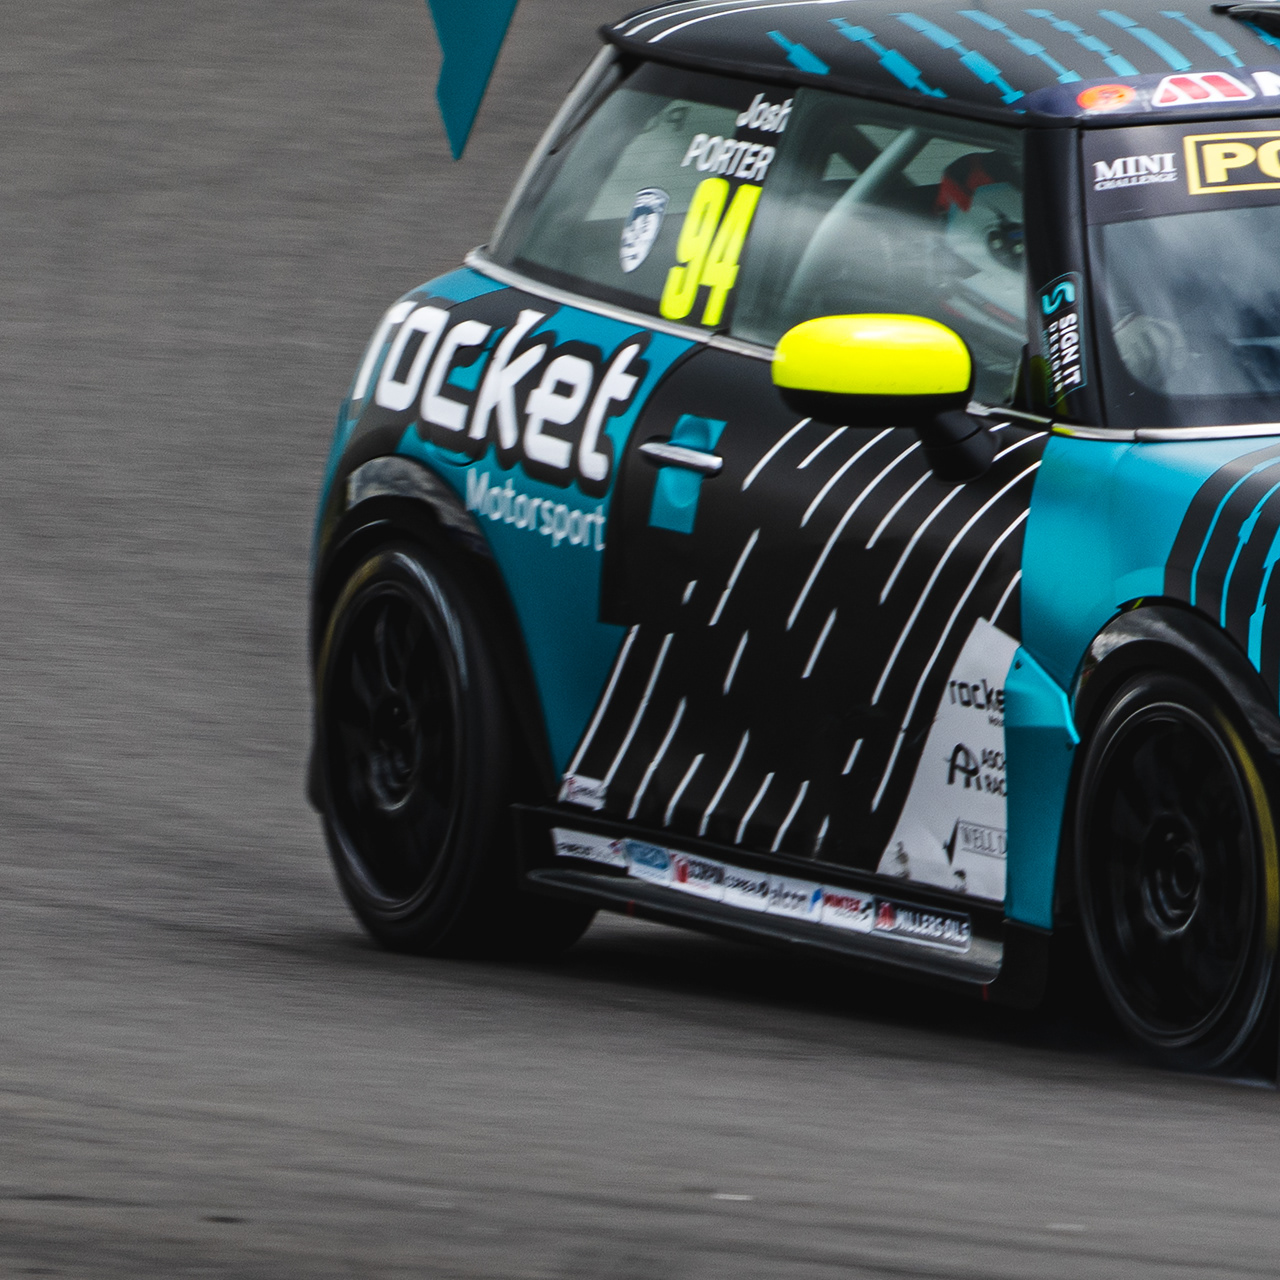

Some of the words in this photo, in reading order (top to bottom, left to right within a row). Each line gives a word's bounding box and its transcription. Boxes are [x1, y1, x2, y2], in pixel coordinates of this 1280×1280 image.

[736, 92, 794, 133] Josh
[681, 133, 776, 181] PORTER
[1093, 153, 1178, 182] MINI
[1094, 173, 1178, 192] CHALLENGE
[659, 177, 763, 326] 94
[1058, 312, 1081, 366] SIGN
[352, 299, 640, 481] rocket
[1061, 364, 1082, 385] IT
[466, 467, 606, 552] Motorsport
